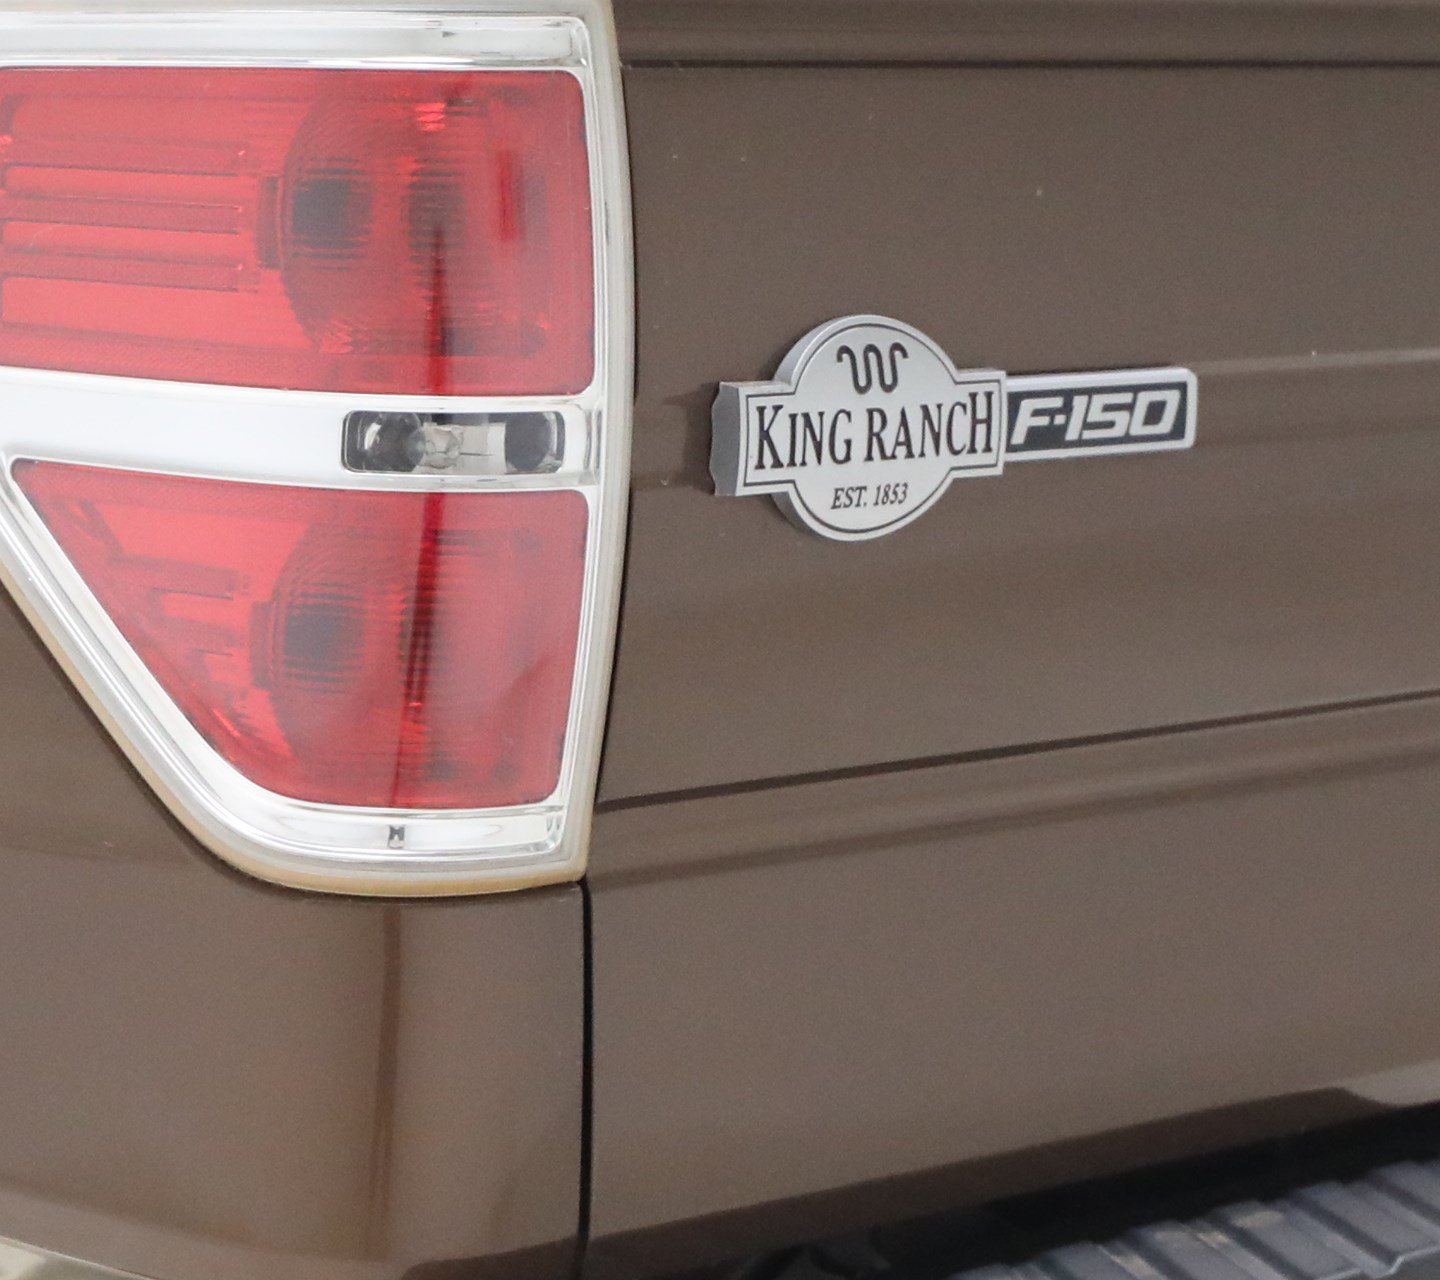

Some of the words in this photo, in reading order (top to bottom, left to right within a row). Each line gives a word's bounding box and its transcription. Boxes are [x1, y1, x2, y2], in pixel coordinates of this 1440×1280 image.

[754, 404, 852, 470] KING
[864, 391, 994, 462] RANCH
[1011, 389, 1181, 445] F-150
[830, 486, 868, 510] EST.
[873, 483, 908, 505] 1853
